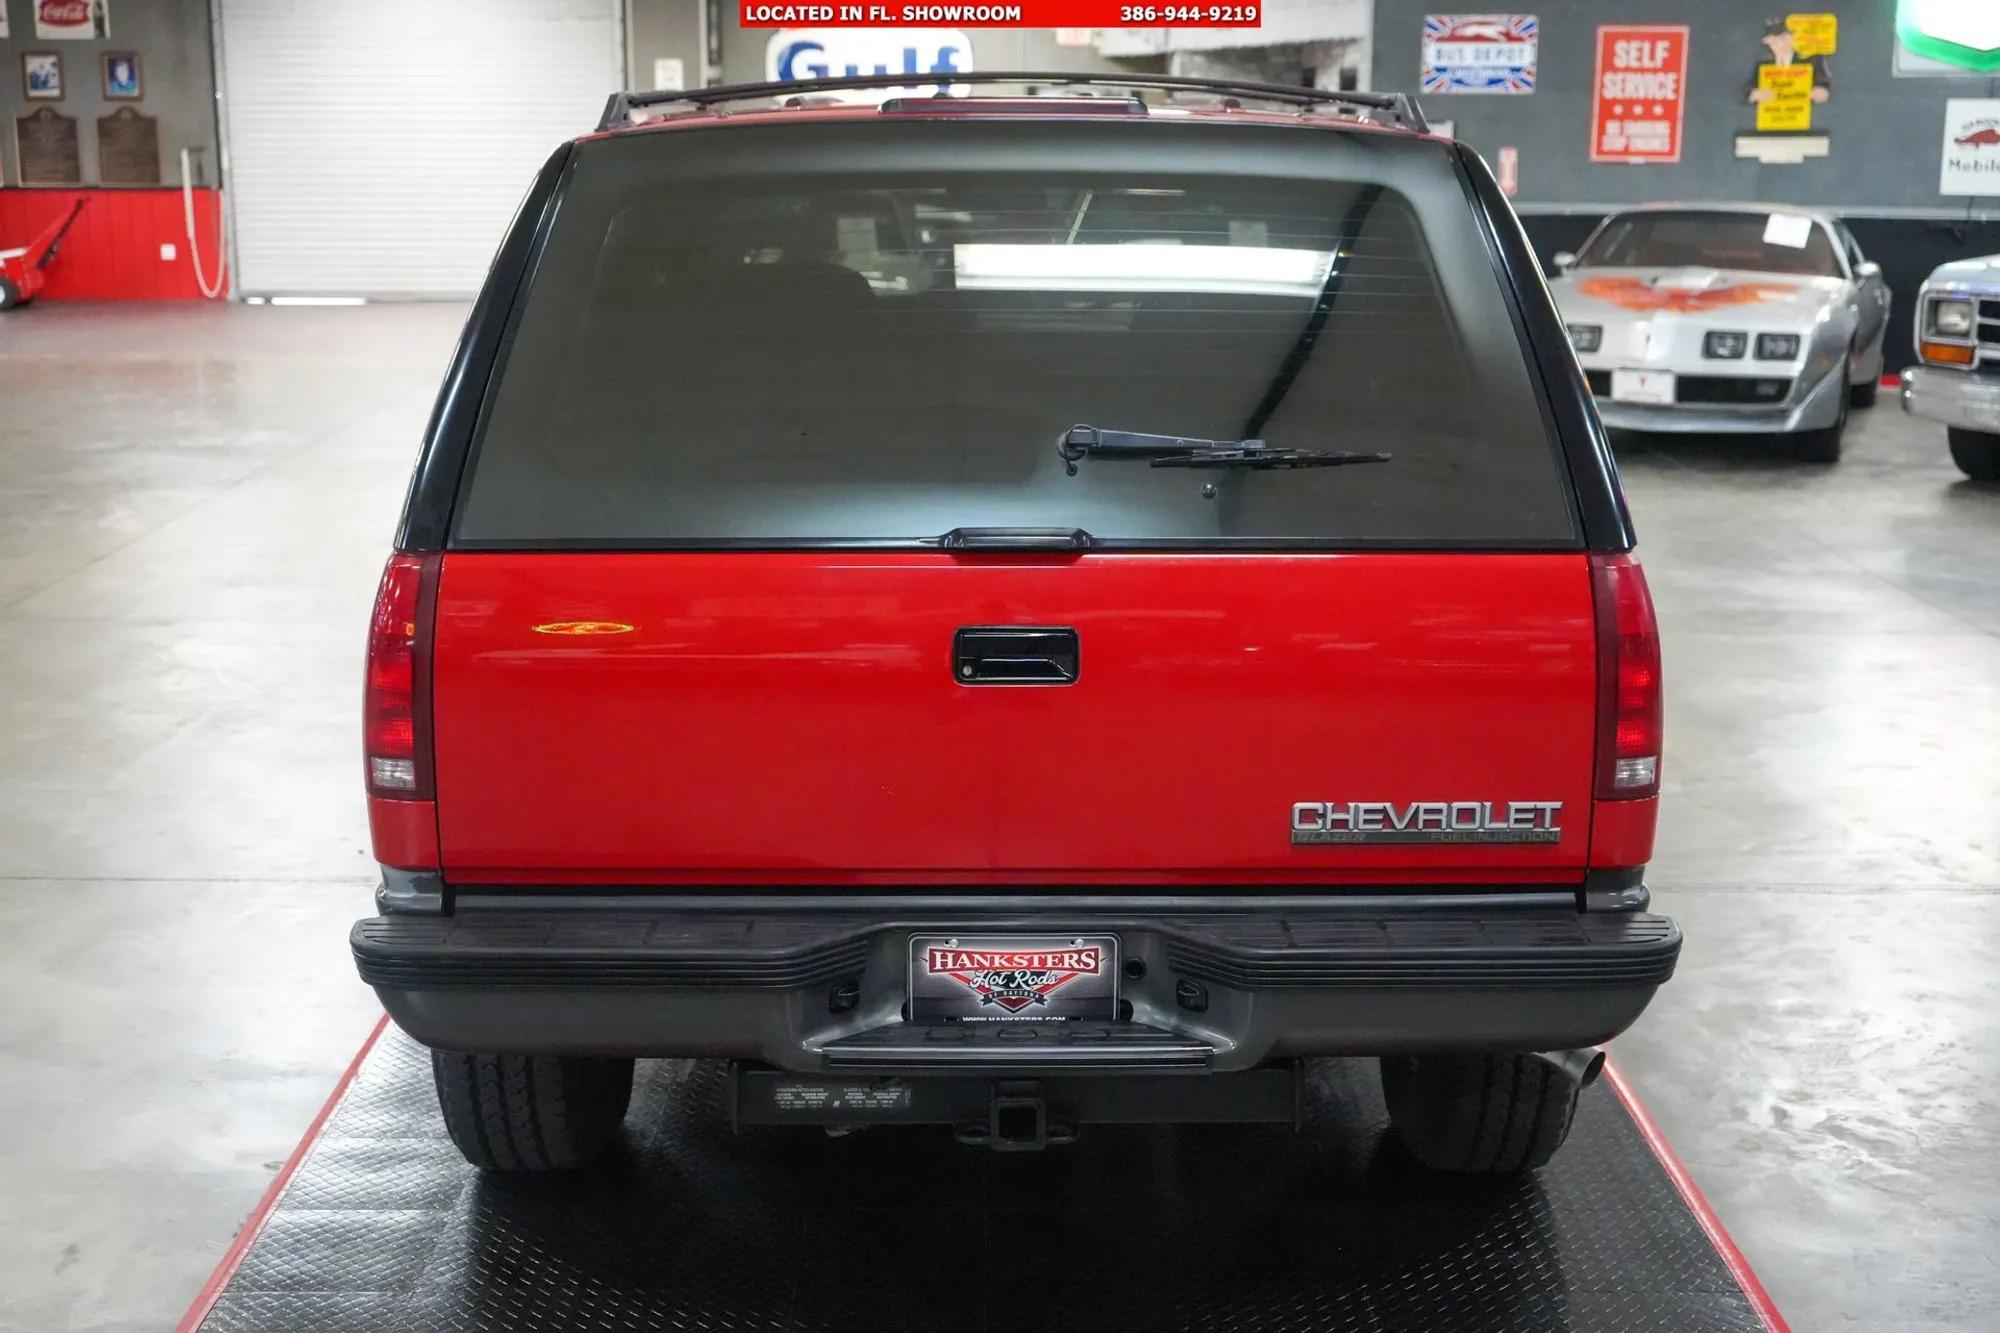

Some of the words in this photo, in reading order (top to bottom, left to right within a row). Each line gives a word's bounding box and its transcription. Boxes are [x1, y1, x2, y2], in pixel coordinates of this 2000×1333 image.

[1613, 39, 1670, 69] SELF
[1602, 71, 1678, 100] SERVICE
[1292, 801, 1563, 830] CHEVROLET
[1430, 831, 1472, 842] FUEL
[1474, 831, 1556, 842] INJECTION
[934, 950, 1096, 970] HANKSTERS
[969, 969, 1007, 989] Hot
[1009, 969, 1060, 990] Rods
[1003, 990, 1040, 999] DAYTONA
